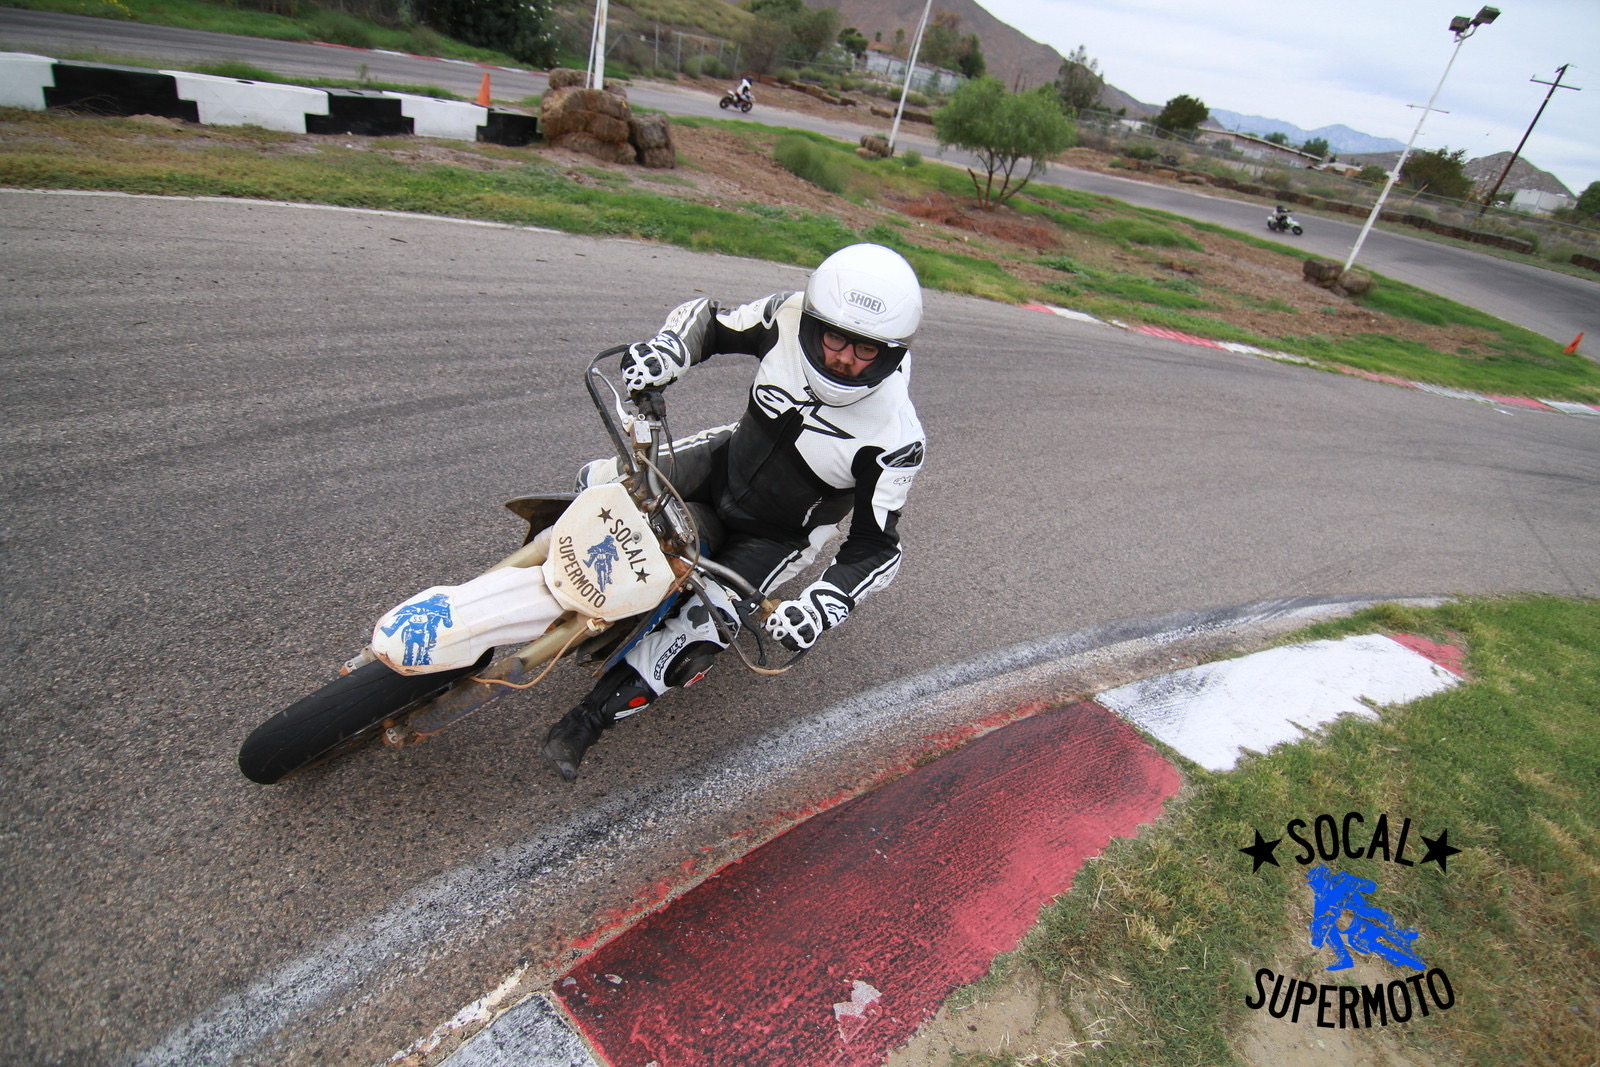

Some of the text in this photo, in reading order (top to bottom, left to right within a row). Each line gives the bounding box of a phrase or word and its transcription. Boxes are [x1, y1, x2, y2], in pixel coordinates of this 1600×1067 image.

[848, 291, 881, 312] SHOEI
[609, 518, 647, 570] SOCAL
[558, 535, 606, 608] SUPERMOTO
